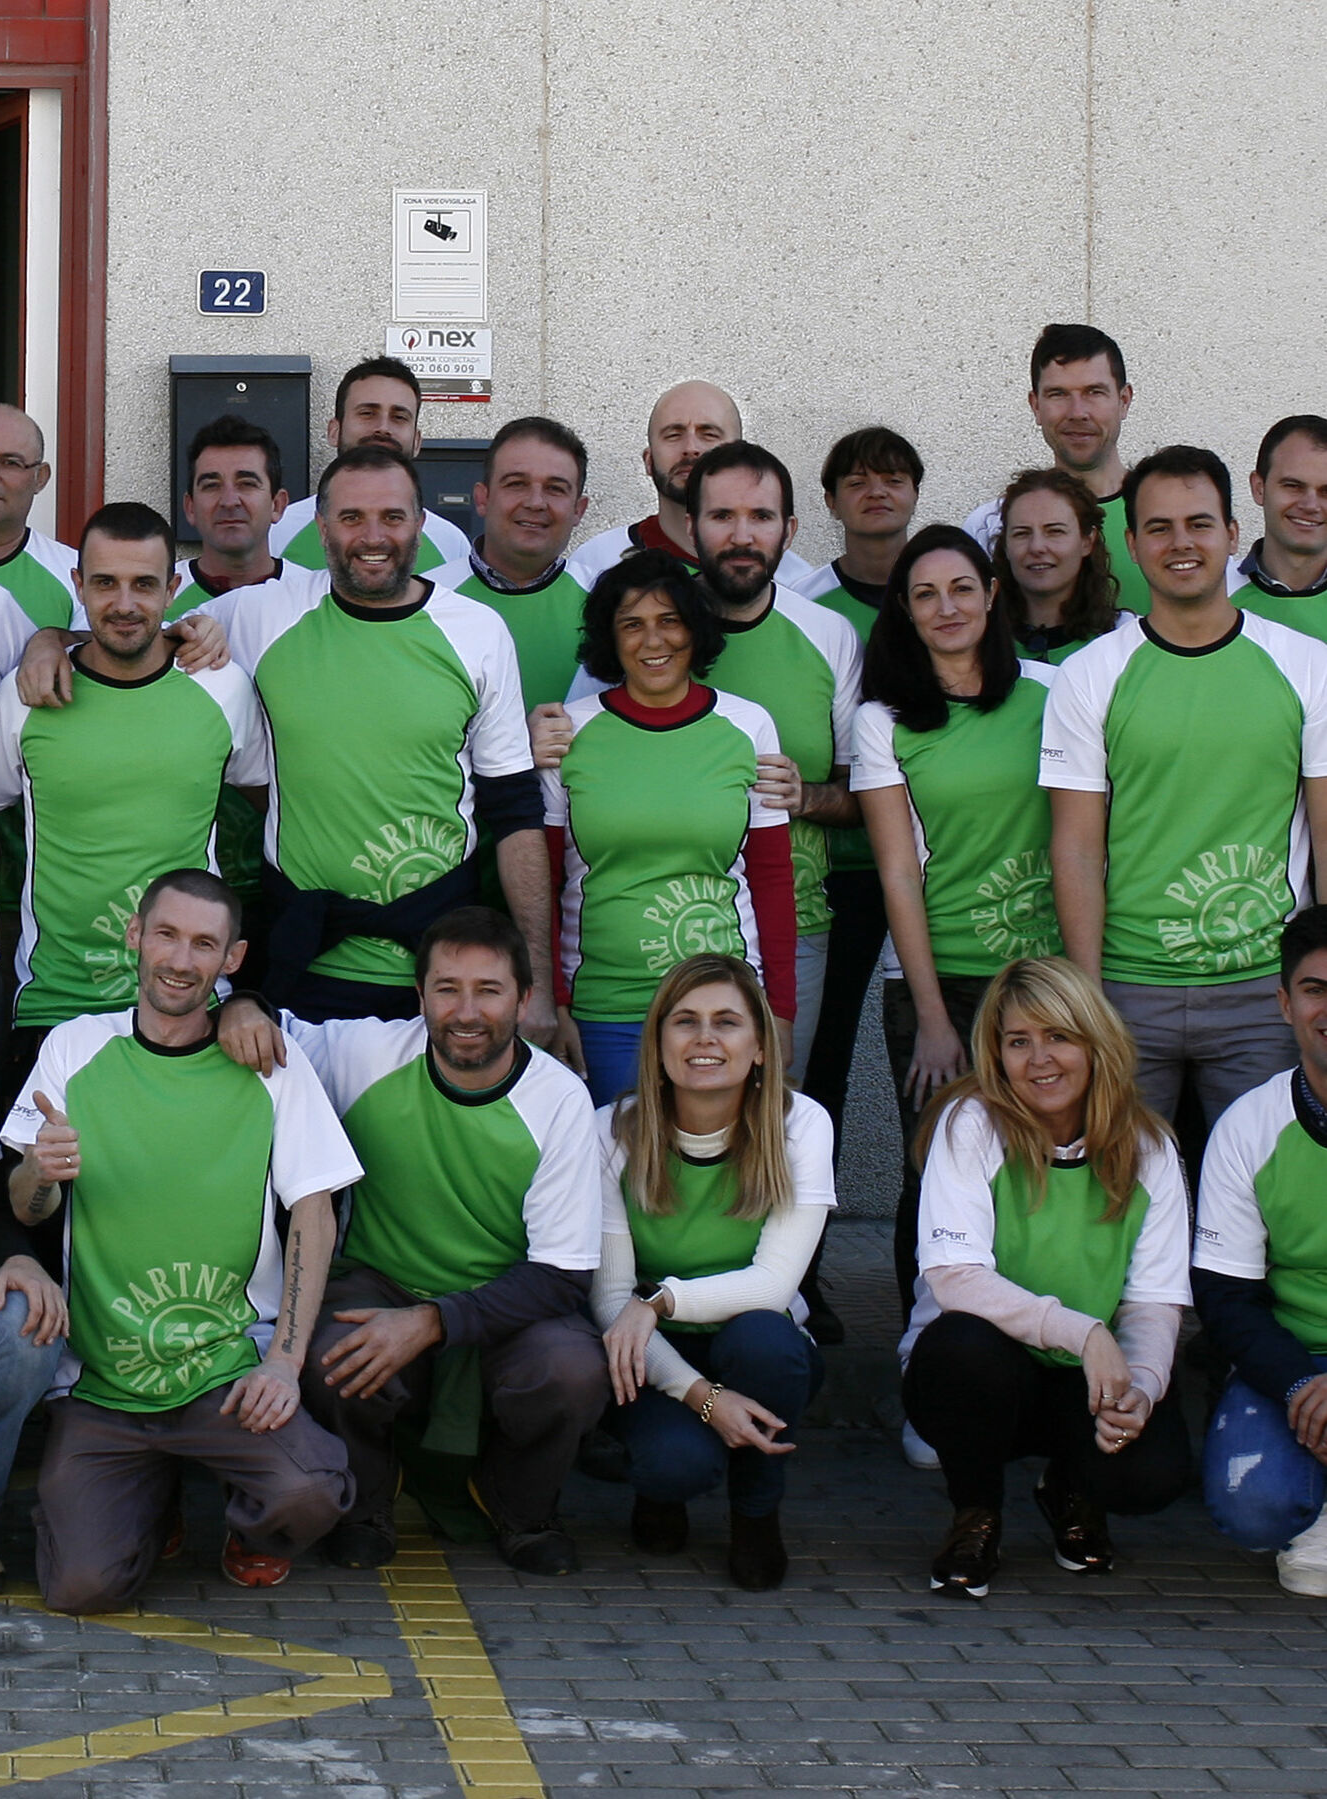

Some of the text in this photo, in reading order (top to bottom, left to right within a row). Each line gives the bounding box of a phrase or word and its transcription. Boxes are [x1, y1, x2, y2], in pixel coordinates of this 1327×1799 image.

[214, 278, 251, 307] 22
[428, 330, 476, 348] nex
[429, 363, 450, 373] 060
[454, 364, 475, 373] 909
[350, 815, 466, 881] PARTNER
